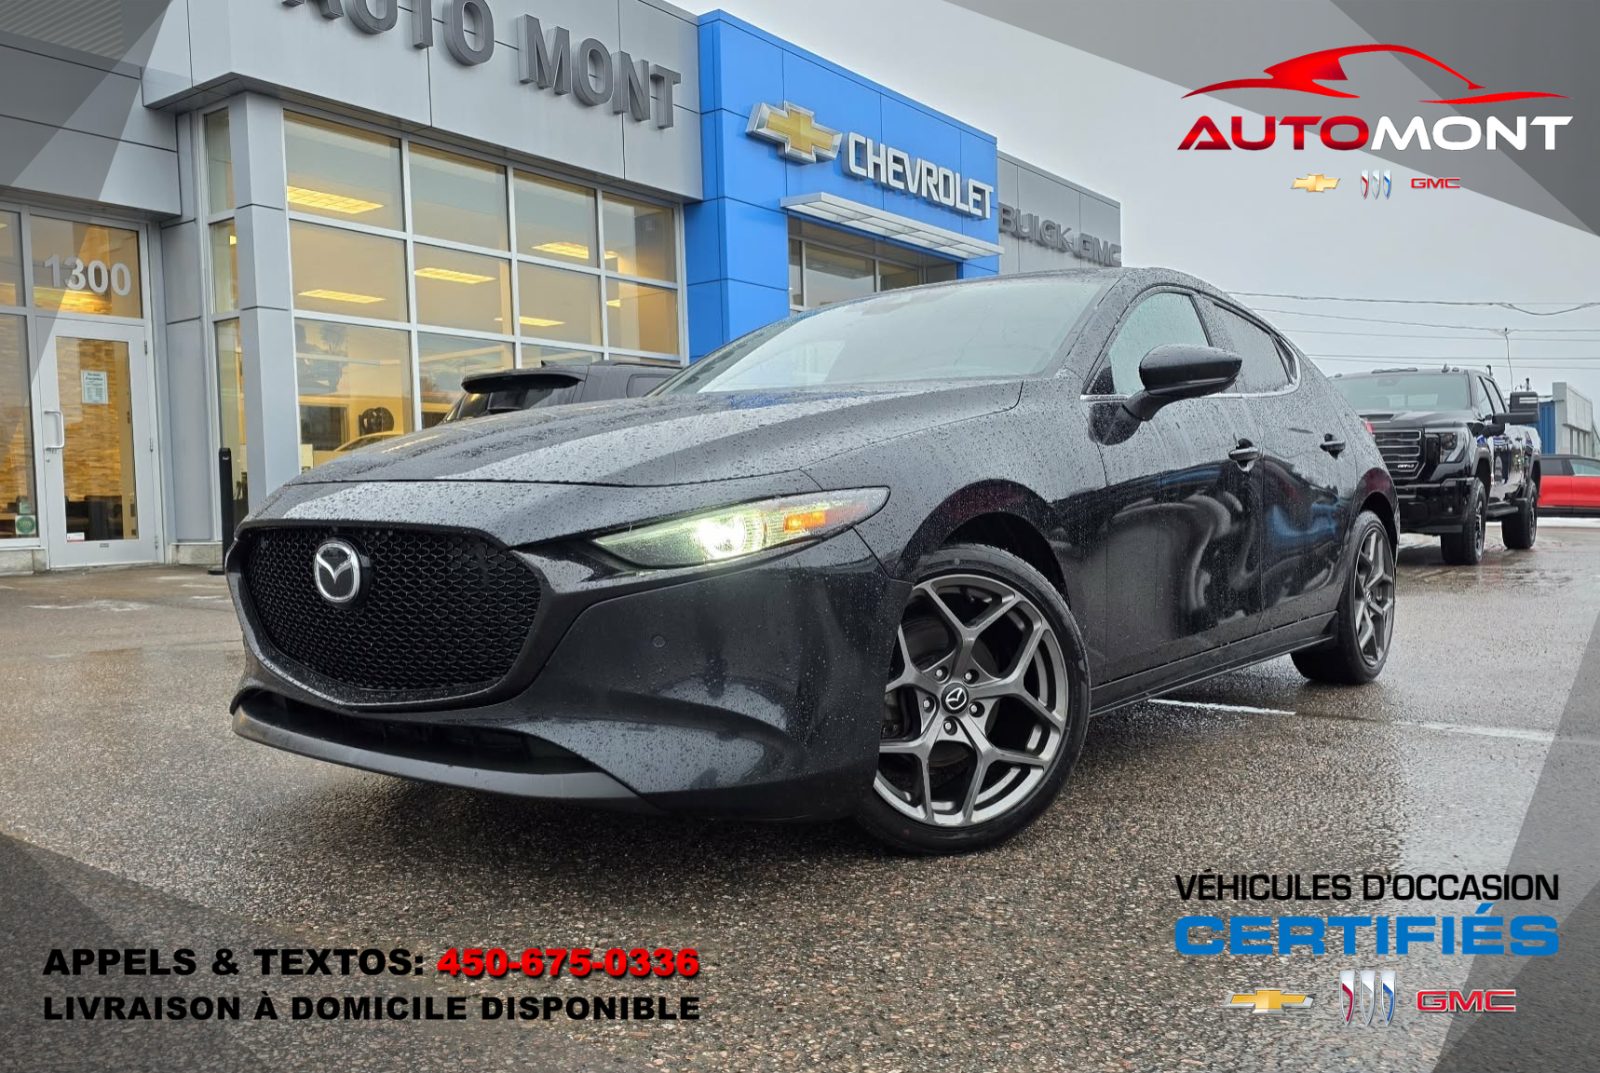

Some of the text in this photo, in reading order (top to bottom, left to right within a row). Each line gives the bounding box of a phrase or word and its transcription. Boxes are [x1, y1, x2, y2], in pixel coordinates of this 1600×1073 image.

[281, 0, 682, 129] UTO MONT
[841, 131, 994, 219] CHEVROLET
[998, 202, 1122, 268] BUICK GMC
[44, 254, 132, 297] 1300
